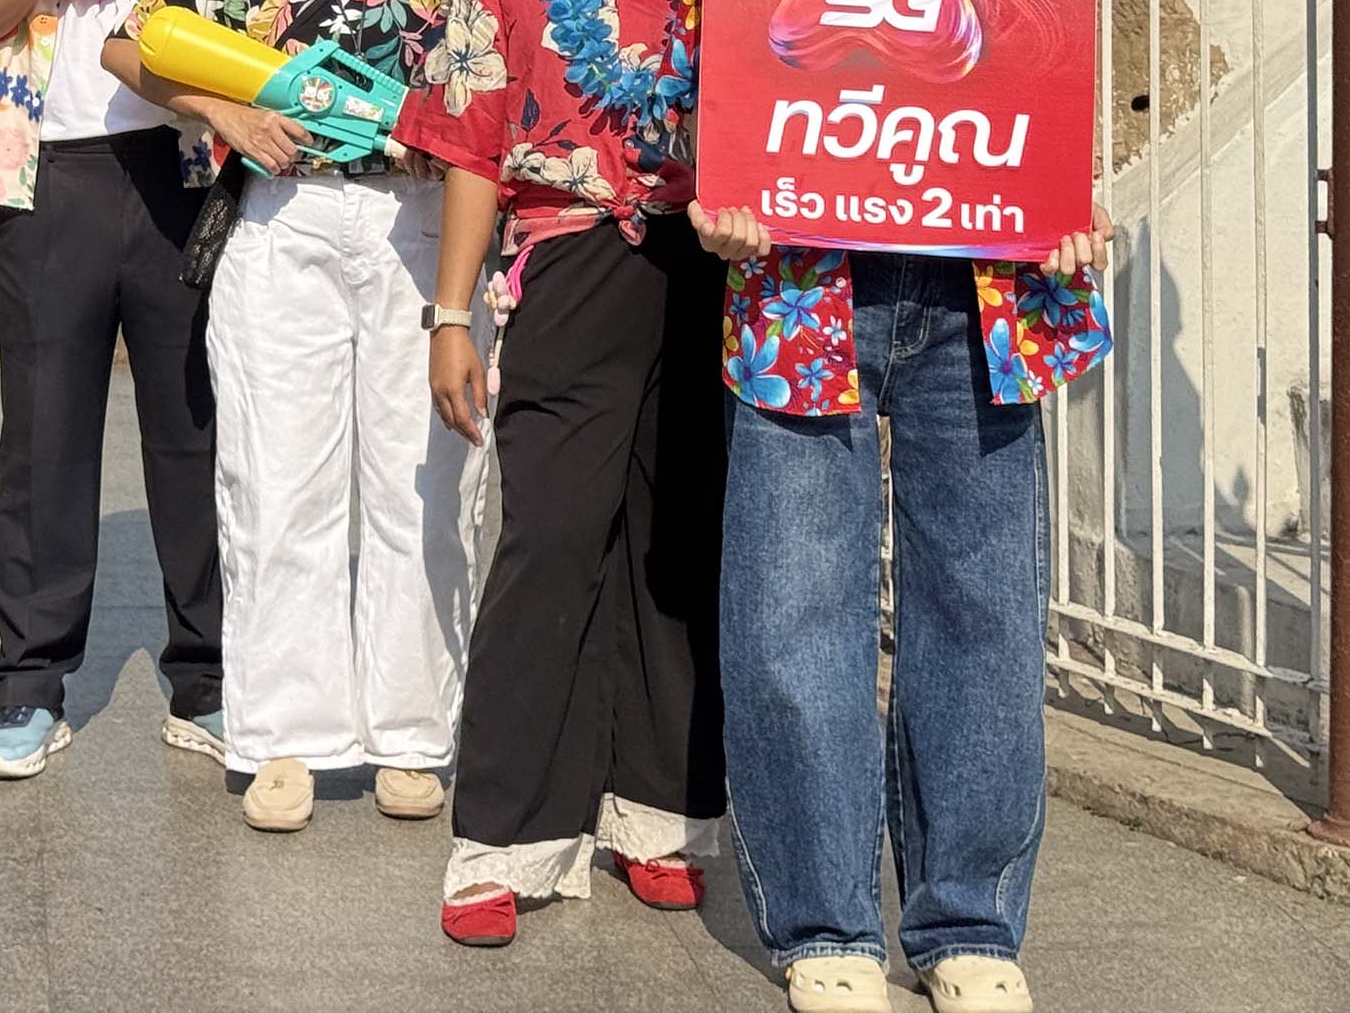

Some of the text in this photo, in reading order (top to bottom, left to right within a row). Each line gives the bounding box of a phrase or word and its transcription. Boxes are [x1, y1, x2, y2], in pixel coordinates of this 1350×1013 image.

[765, 84, 1031, 186] ทวีคูณ
[761, 176, 1026, 234] เร็ว แรง 2 เท่า
